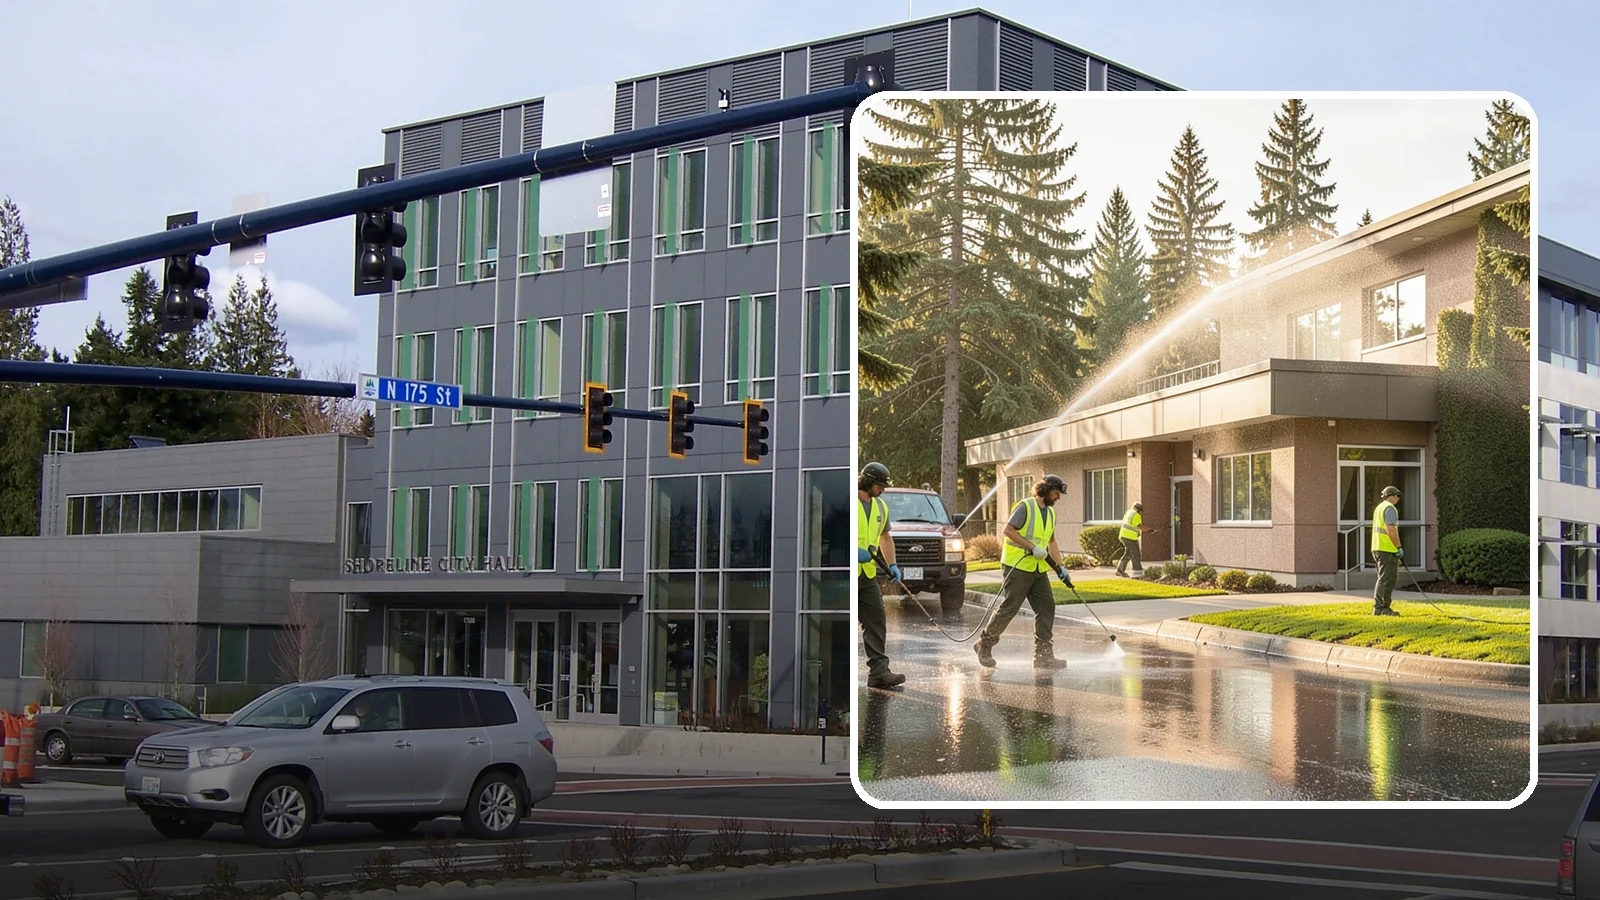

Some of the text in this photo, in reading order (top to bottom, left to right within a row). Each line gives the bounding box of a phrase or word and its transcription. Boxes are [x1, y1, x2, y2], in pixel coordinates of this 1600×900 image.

[387, 380, 451, 406] N 175 St
[343, 555, 526, 574] SHORELINE CITY HALL
